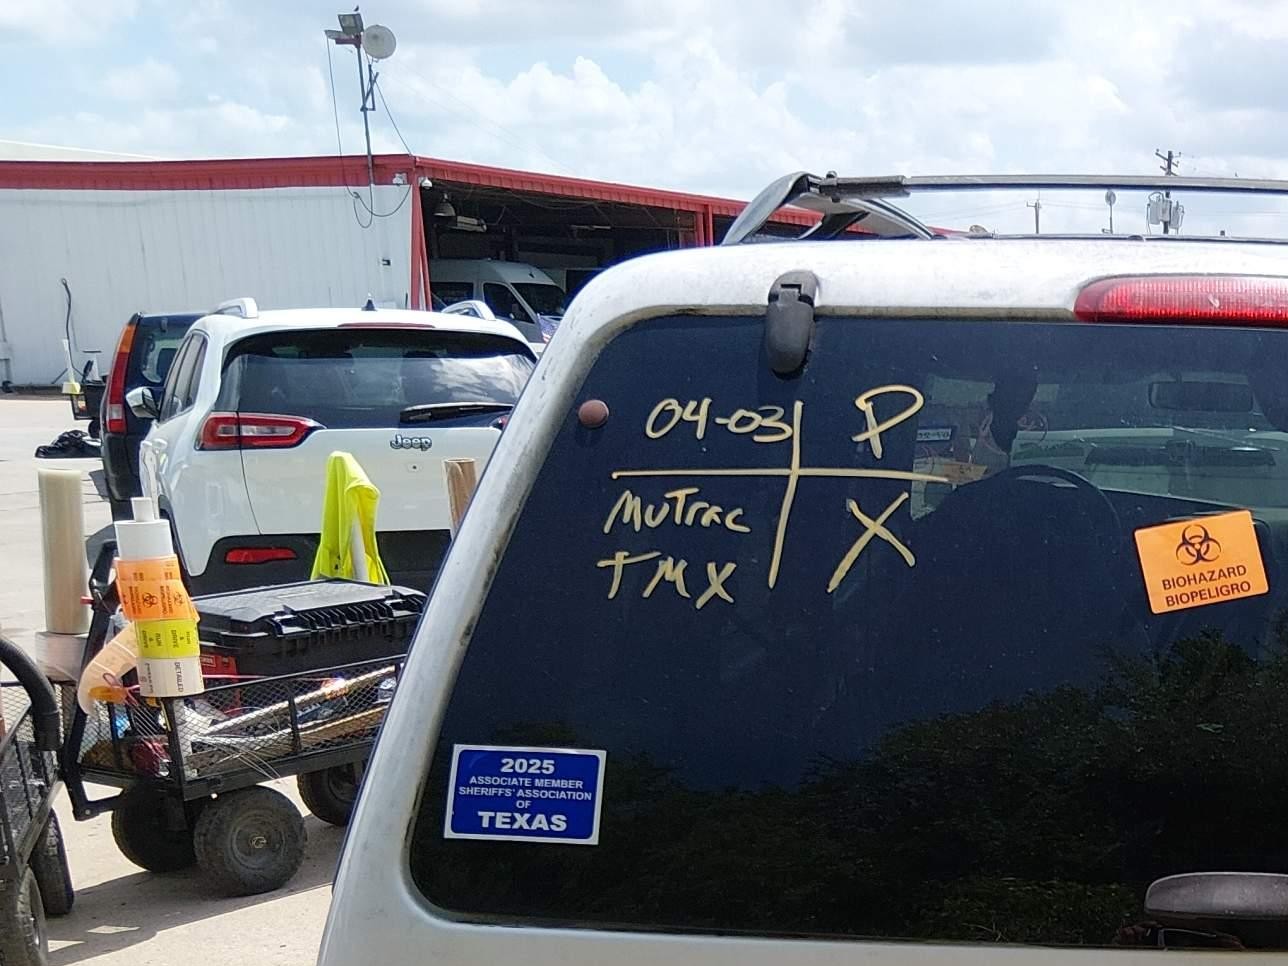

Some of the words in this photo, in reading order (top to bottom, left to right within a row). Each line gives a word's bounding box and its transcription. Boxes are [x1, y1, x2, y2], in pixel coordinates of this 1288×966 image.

[645, 398, 793, 442] 04-03
[851, 385, 924, 459] P
[390, 434, 432, 451] Jeep
[826, 492, 916, 593] X
[1162, 564, 1247, 590] BIOHAZARD
[1165, 580, 1251, 607] BIOPELIGRO
[174, 661, 184, 692] DETAILED
[500, 758, 555, 774] 2025
[458, 787, 516, 797] SHERIFFS'
[516, 789, 592, 800] ASSOCIATION
[469, 776, 532, 787] ASSOCIATE
[534, 778, 583, 789] MEMBER
[515, 799, 533, 809] OF
[477, 811, 568, 832] TEXAS
